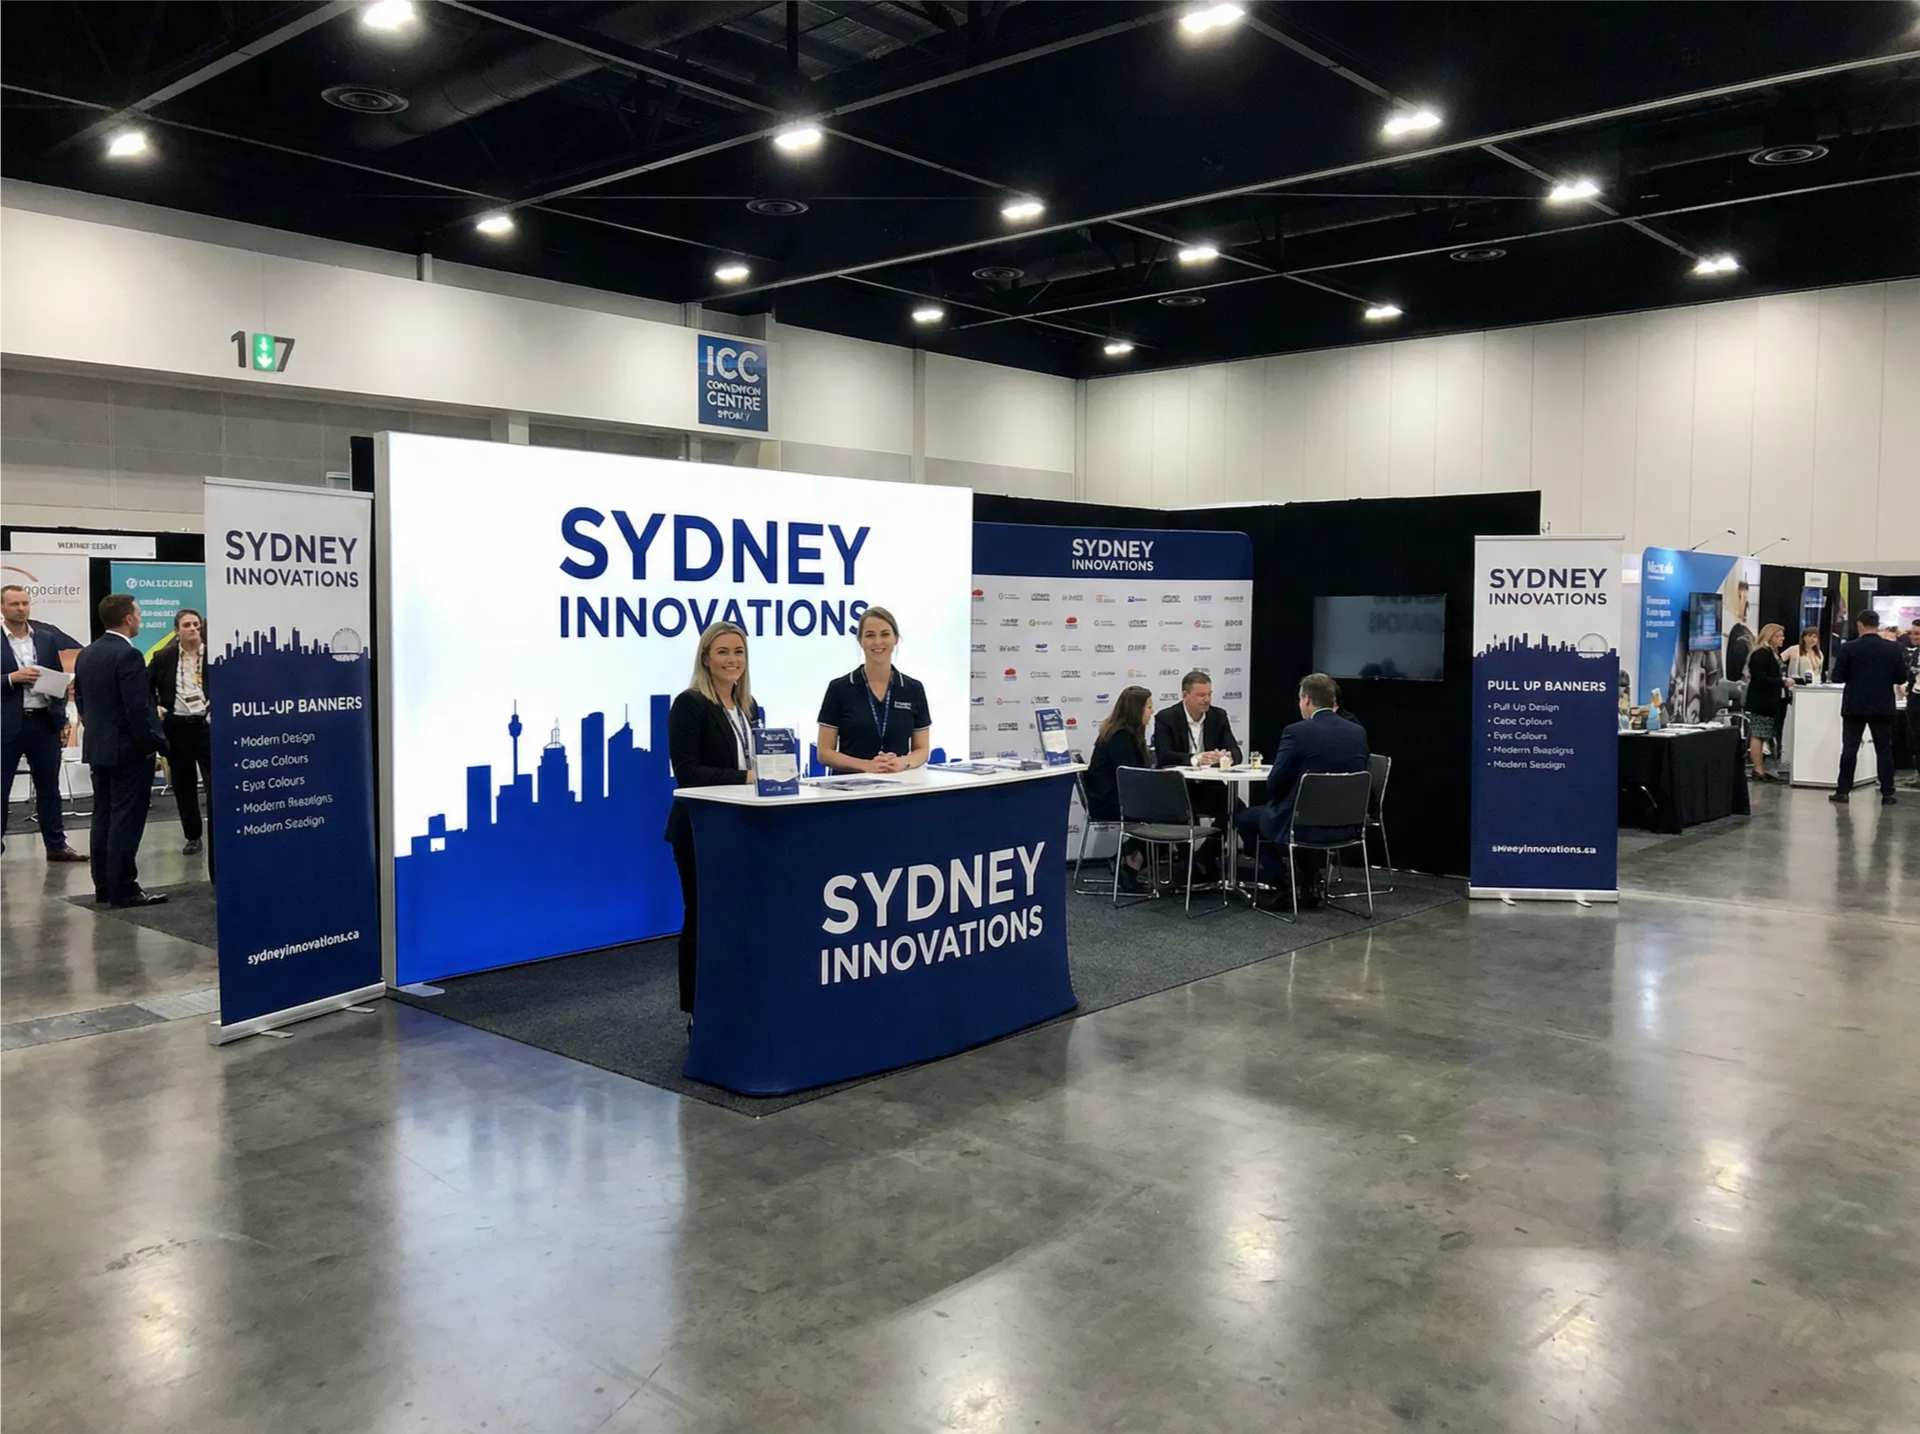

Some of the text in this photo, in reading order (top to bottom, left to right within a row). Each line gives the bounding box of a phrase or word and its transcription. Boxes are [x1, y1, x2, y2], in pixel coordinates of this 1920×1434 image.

[707, 345, 760, 383] ICC
[707, 391, 761, 411] CENTRE
[225, 530, 358, 565] SYDNEY
[559, 506, 871, 585] SYDNEY
[1072, 538, 1154, 558] SYDNEY
[1072, 559, 1154, 571] INNOVATIONS
[226, 567, 359, 587] INNOVATIONS
[1489, 568, 1608, 588] SYDNEY
[1489, 593, 1608, 605] INNOVATIONS
[1487, 680, 1607, 692] PULL UP BANNERS
[232, 696, 363, 717] PULL-UP BANNERS
[1493, 703, 1560, 713] Pull Up Design
[241, 734, 280, 747] Modern
[1514, 731, 1548, 740] Colours
[271, 754, 309, 767] Colours
[267, 776, 306, 788] Colours
[821, 841, 1046, 935] SYDNEY
[821, 905, 1043, 985] INNOVATIONS
